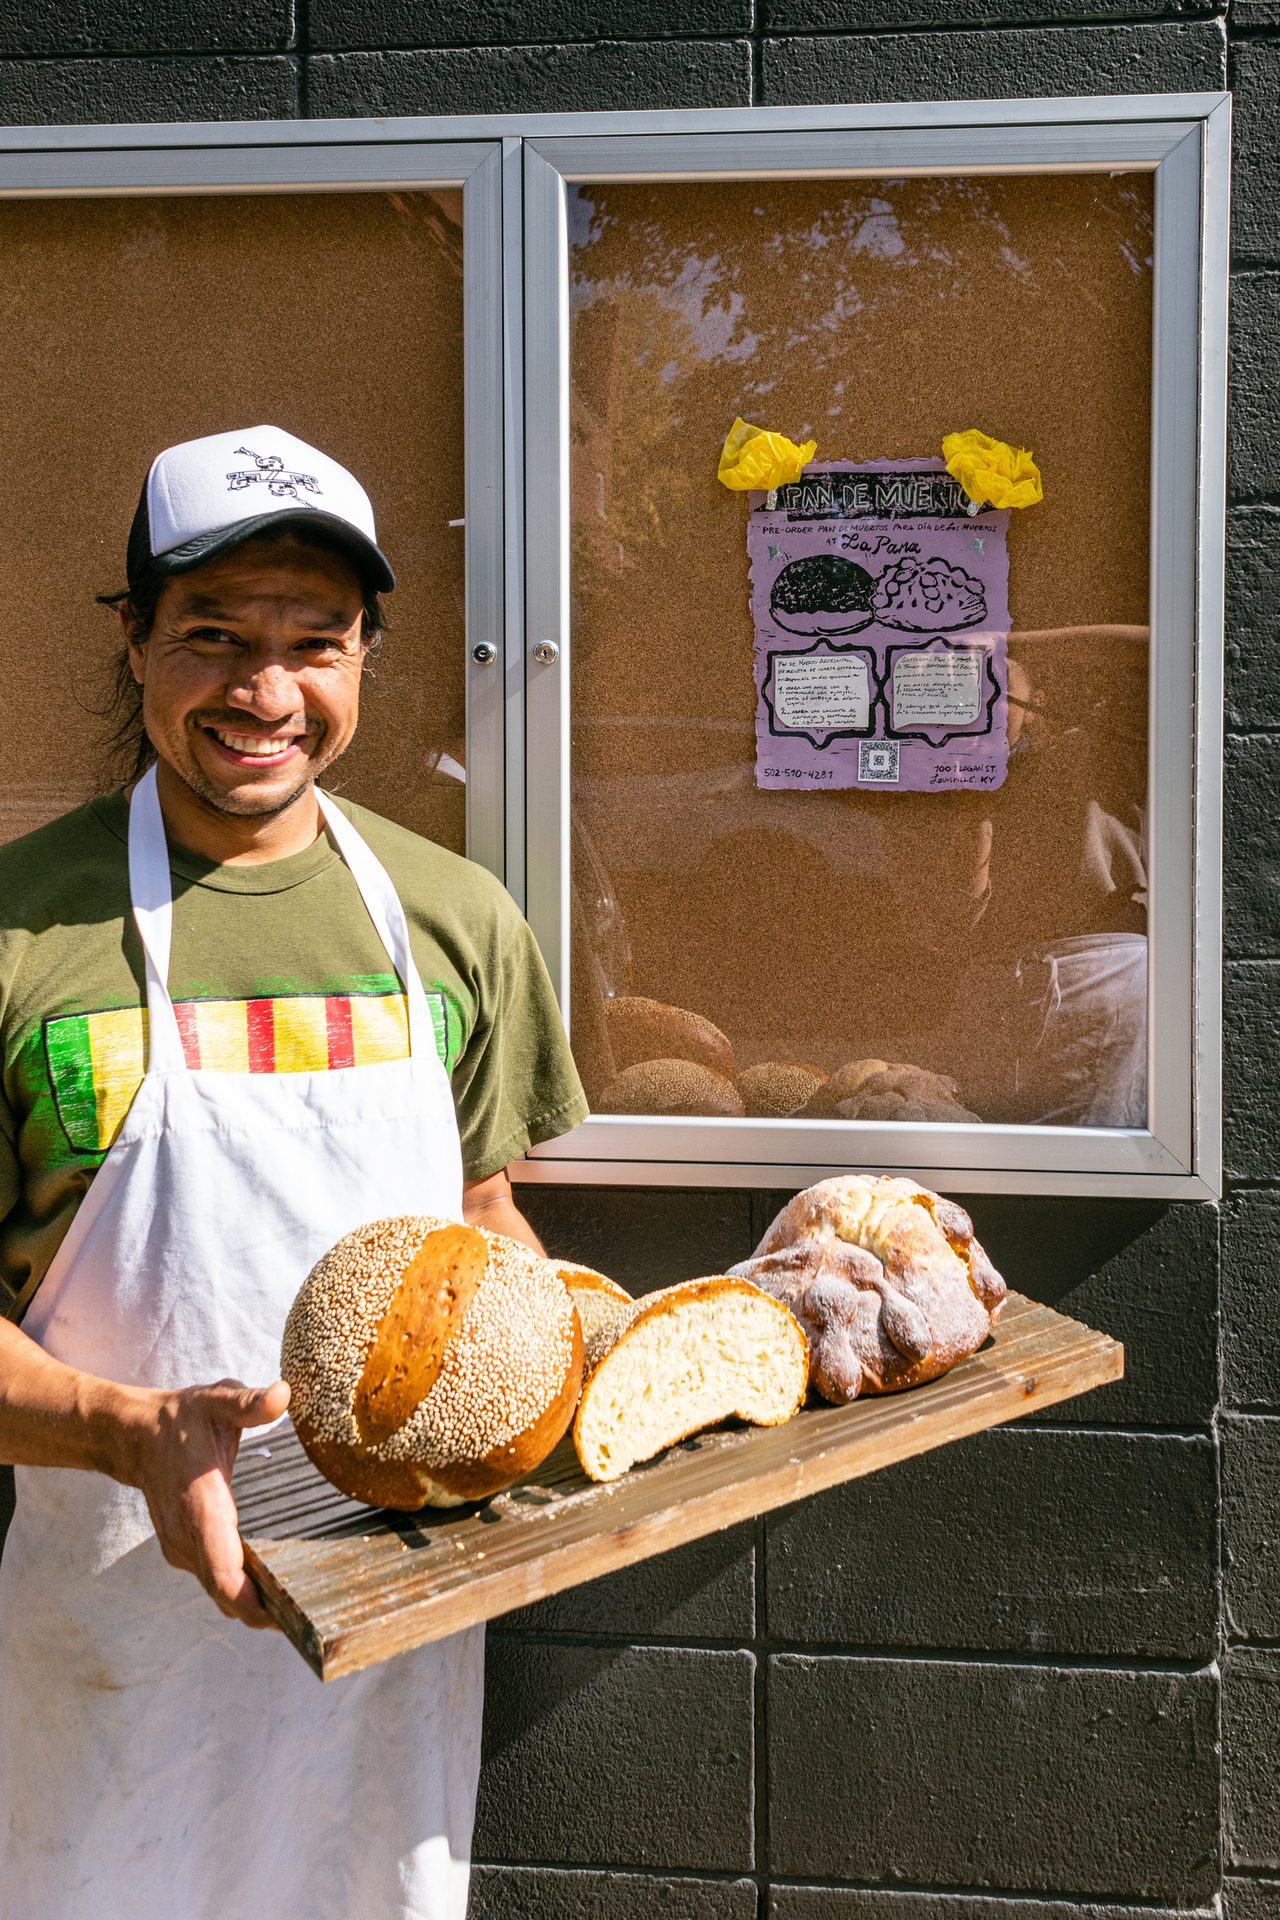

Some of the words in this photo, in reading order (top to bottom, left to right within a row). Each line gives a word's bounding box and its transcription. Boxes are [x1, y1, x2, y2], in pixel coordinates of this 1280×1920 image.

[786, 486, 834, 511] PAN
[842, 484, 870, 509] DE
[762, 526, 813, 534] PRE-ORDER
[817, 525, 836, 533] PAN
[850, 524, 889, 532] MUERTOS
[934, 524, 945, 532] DE
[826, 537, 838, 546] AT
[841, 533, 872, 551] La
[872, 535, 922, 555] Pana
[959, 764, 984, 772] LOGAN
[985, 764, 998, 773] ST.
[980, 775, 996, 784] KY
